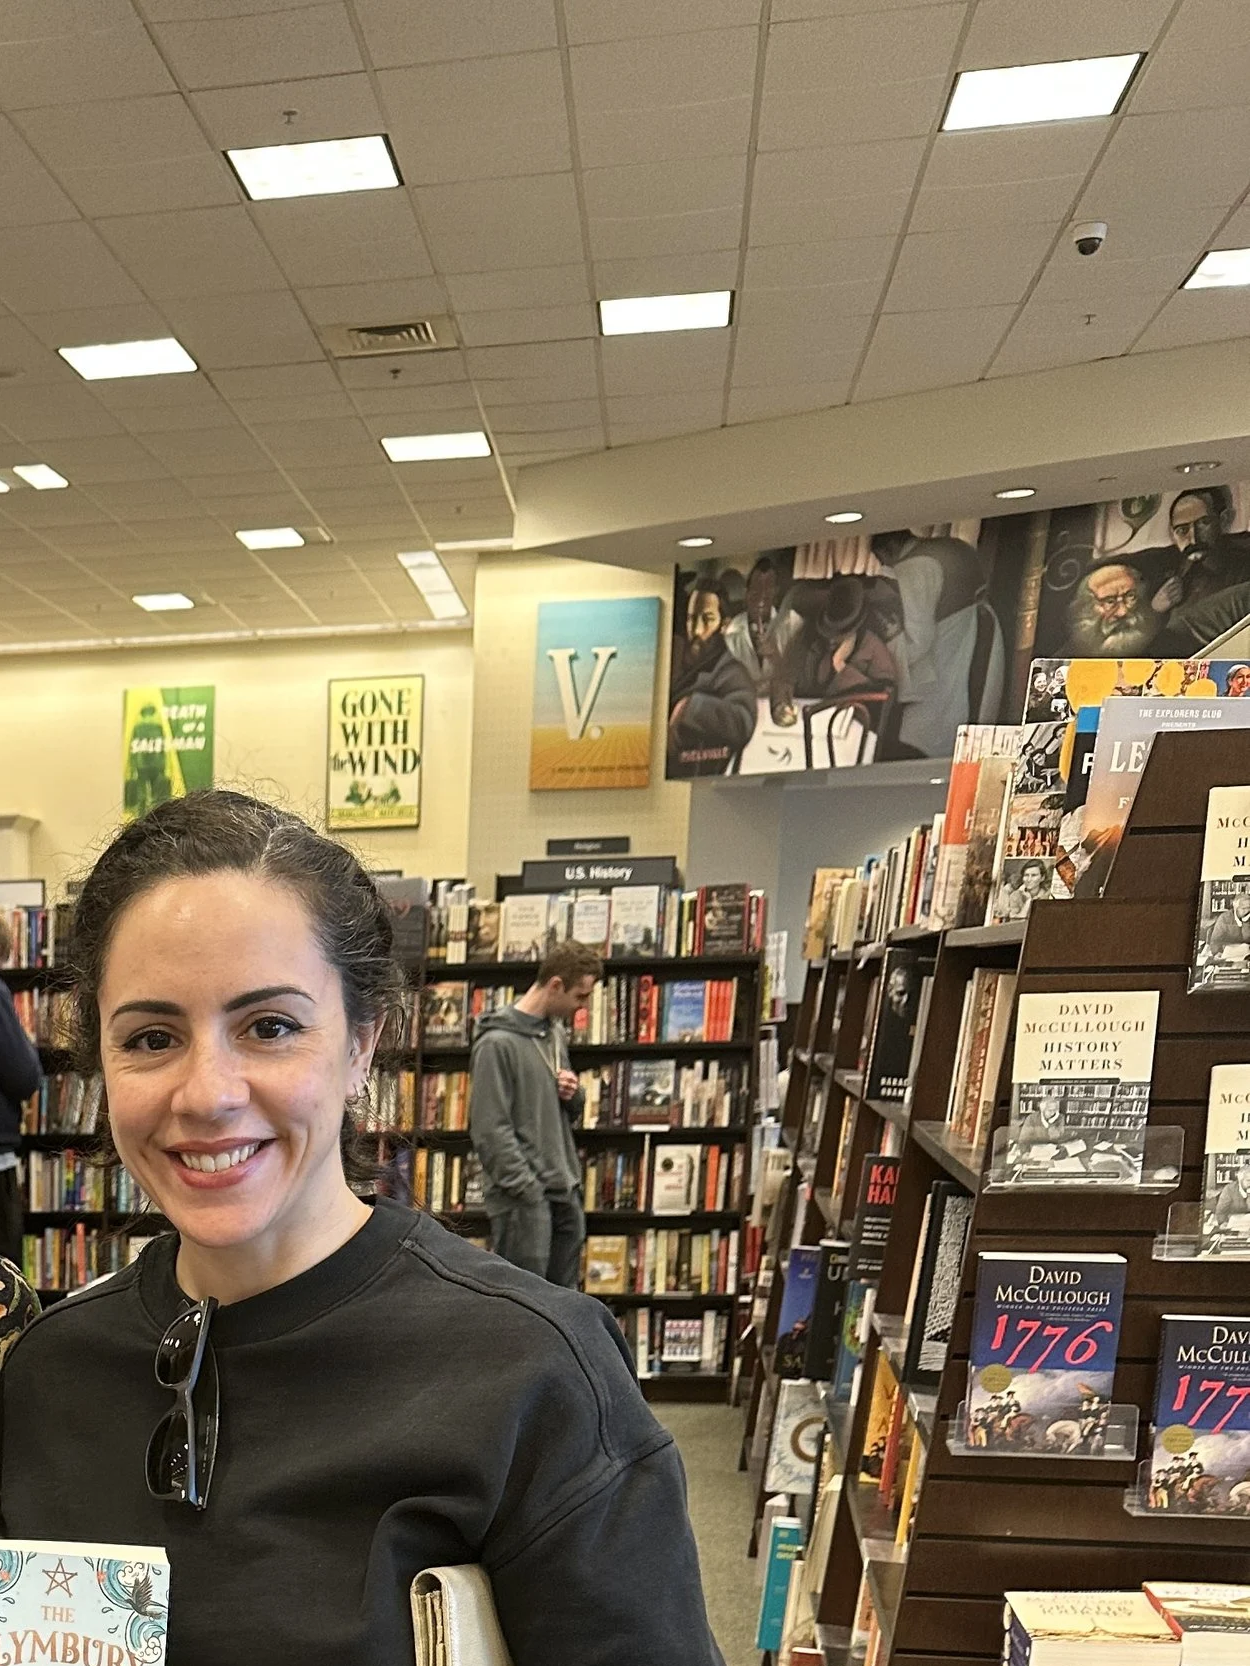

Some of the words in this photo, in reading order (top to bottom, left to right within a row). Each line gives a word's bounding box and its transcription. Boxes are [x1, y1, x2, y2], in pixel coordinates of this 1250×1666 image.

[341, 688, 412, 718] GONE
[163, 704, 207, 719] DEATH
[1139, 709, 1153, 717] THE
[1155, 709, 1199, 718] EXPLORERS
[1202, 709, 1223, 718] CLUB
[340, 720, 410, 746] WITH
[347, 748, 422, 777] WIND
[565, 866, 588, 880] U.S.
[589, 866, 634, 881] History
[1058, 1003, 1114, 1016] DAVID
[1043, 1041, 1123, 1054] HISTORY
[1038, 1059, 1124, 1072] MATTERS
[880, 1076, 909, 1087] BARAC
[880, 1087, 906, 1097] OBAM
[1029, 1265, 1082, 1285] DAVID
[991, 1313, 1114, 1375] 1776
[40, 1605, 77, 1623] THE
